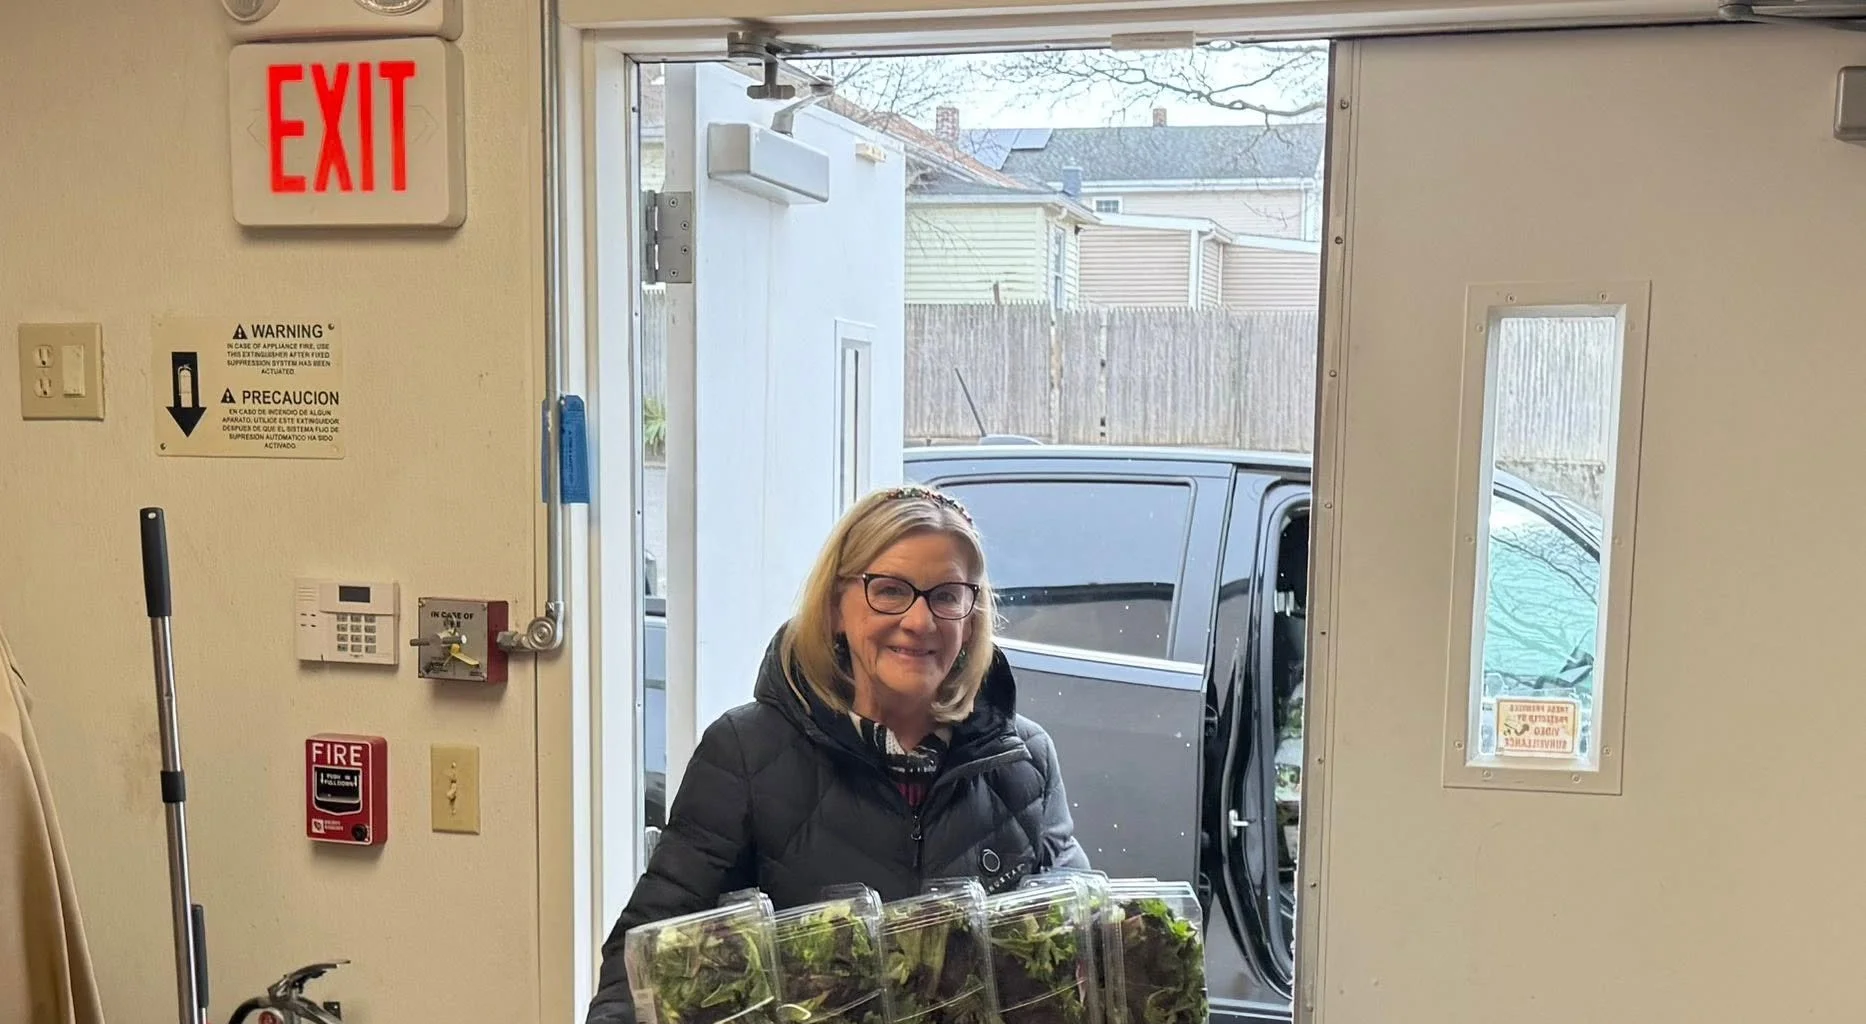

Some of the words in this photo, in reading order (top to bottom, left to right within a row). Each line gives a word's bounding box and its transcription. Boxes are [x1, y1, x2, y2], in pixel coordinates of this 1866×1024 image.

[267, 60, 416, 194] EXIT
[251, 324, 323, 339] WARNING
[242, 390, 339, 405] PRECAUCION
[286, 425, 314, 433] SISTEMA
[441, 611, 462, 619] CASE
[312, 742, 363, 766] FIRE
